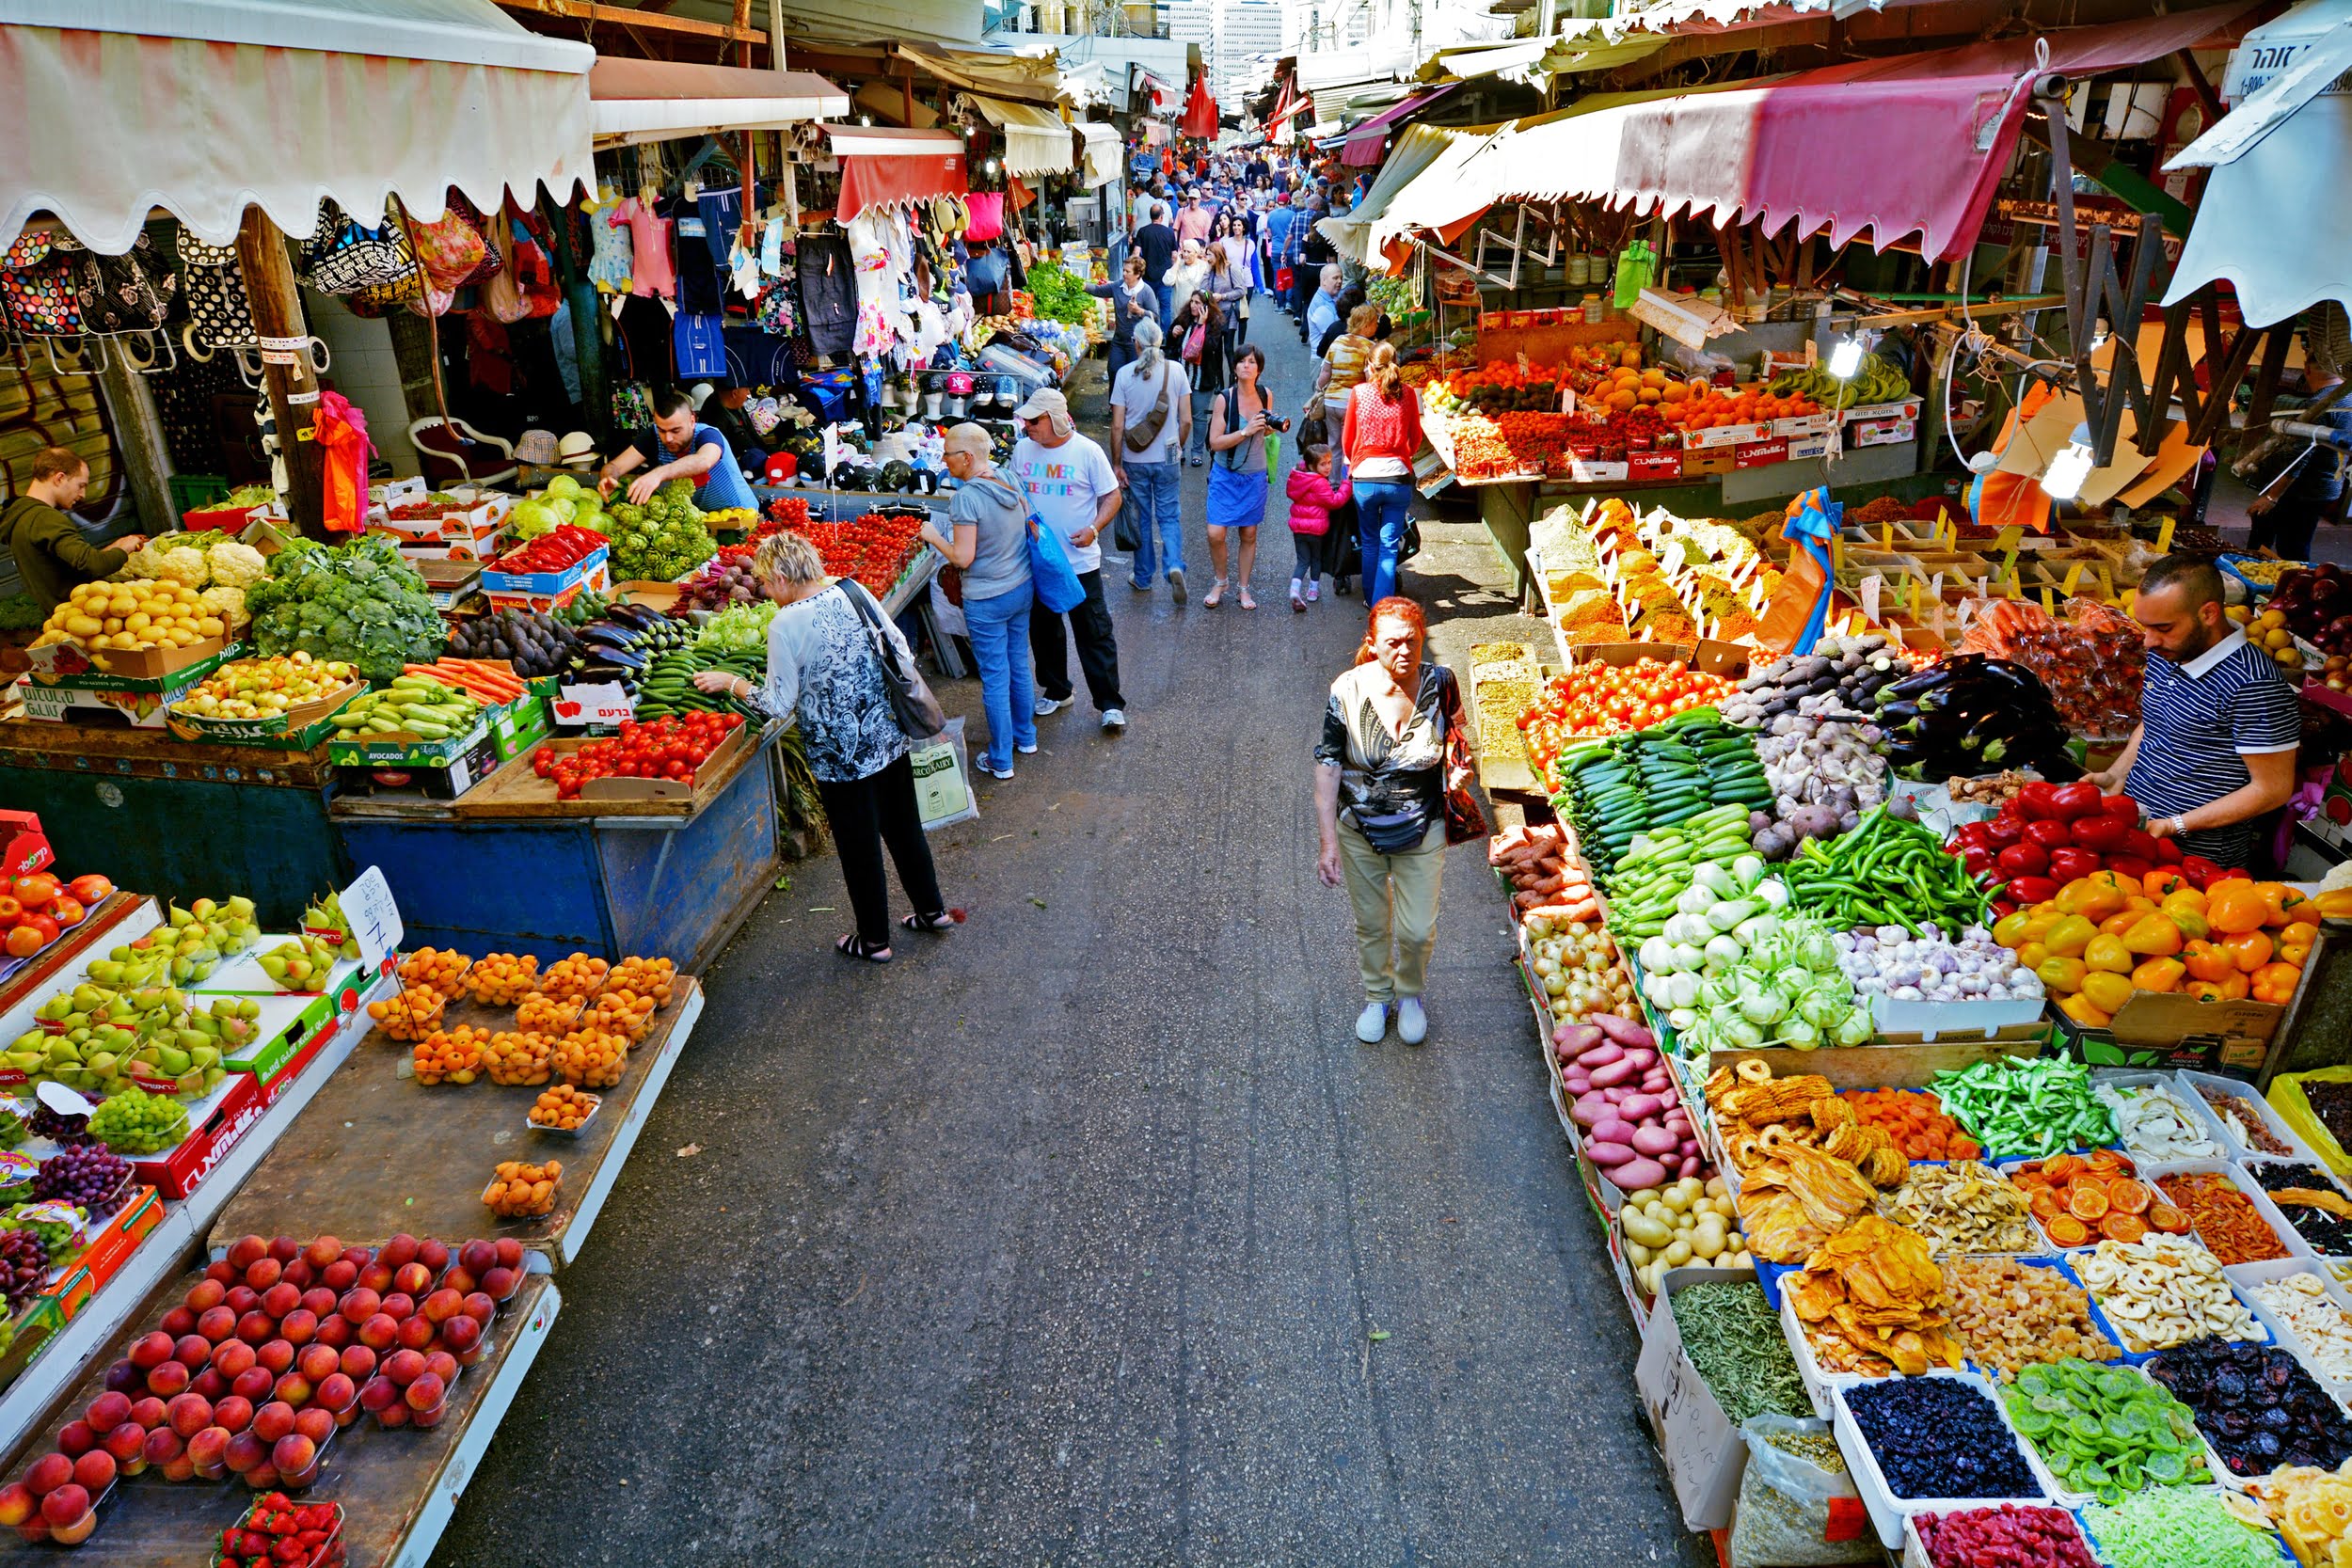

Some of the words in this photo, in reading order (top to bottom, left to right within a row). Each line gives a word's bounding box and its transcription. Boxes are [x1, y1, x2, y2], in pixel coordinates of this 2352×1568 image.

[218, 642, 241, 661] בננות
[597, 707, 630, 718] ברעם
[368, 752, 404, 761] AVOCADOS
